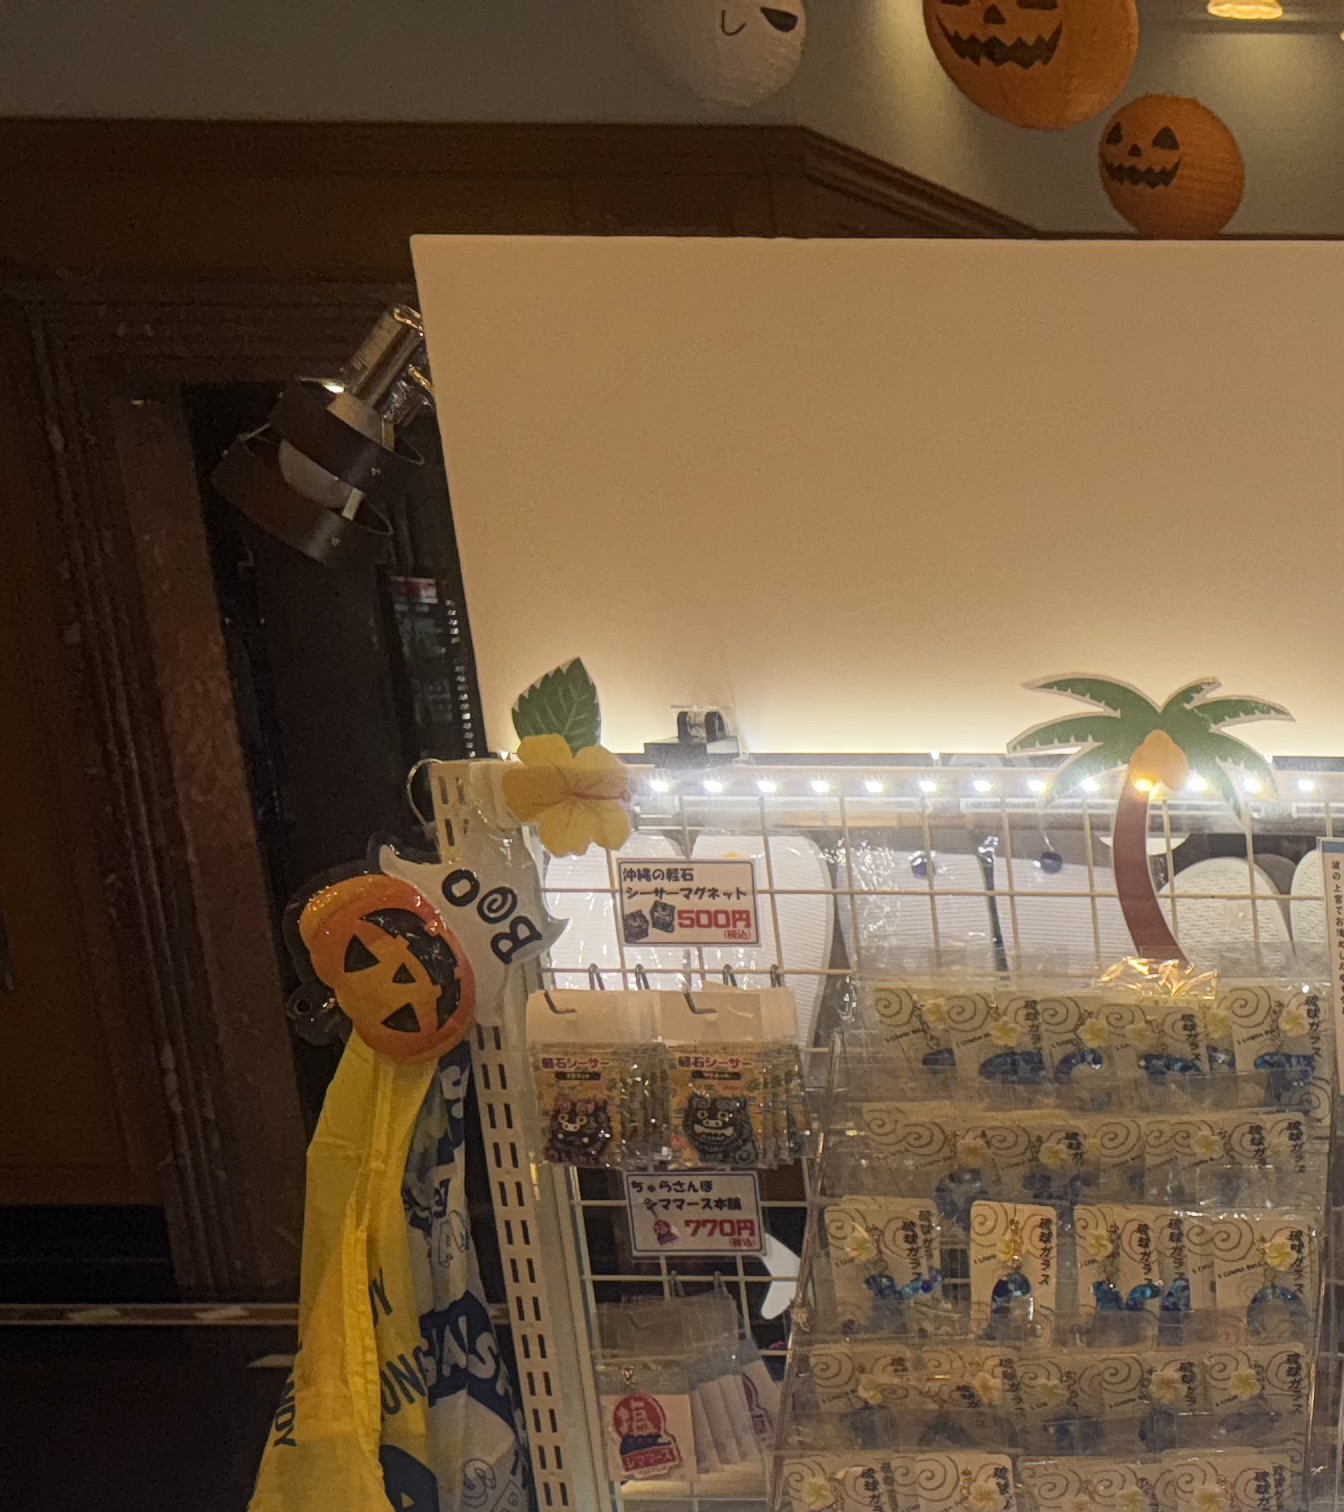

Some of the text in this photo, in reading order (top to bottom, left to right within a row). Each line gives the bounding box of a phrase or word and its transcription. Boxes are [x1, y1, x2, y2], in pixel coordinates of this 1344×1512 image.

[622, 867, 695, 882] 沖縄の軽石
[625, 886, 748, 901] シーサーマグネット
[442, 869, 543, 965] BOO
[677, 909, 751, 929] 500円
[684, 1219, 756, 1237] 770円
